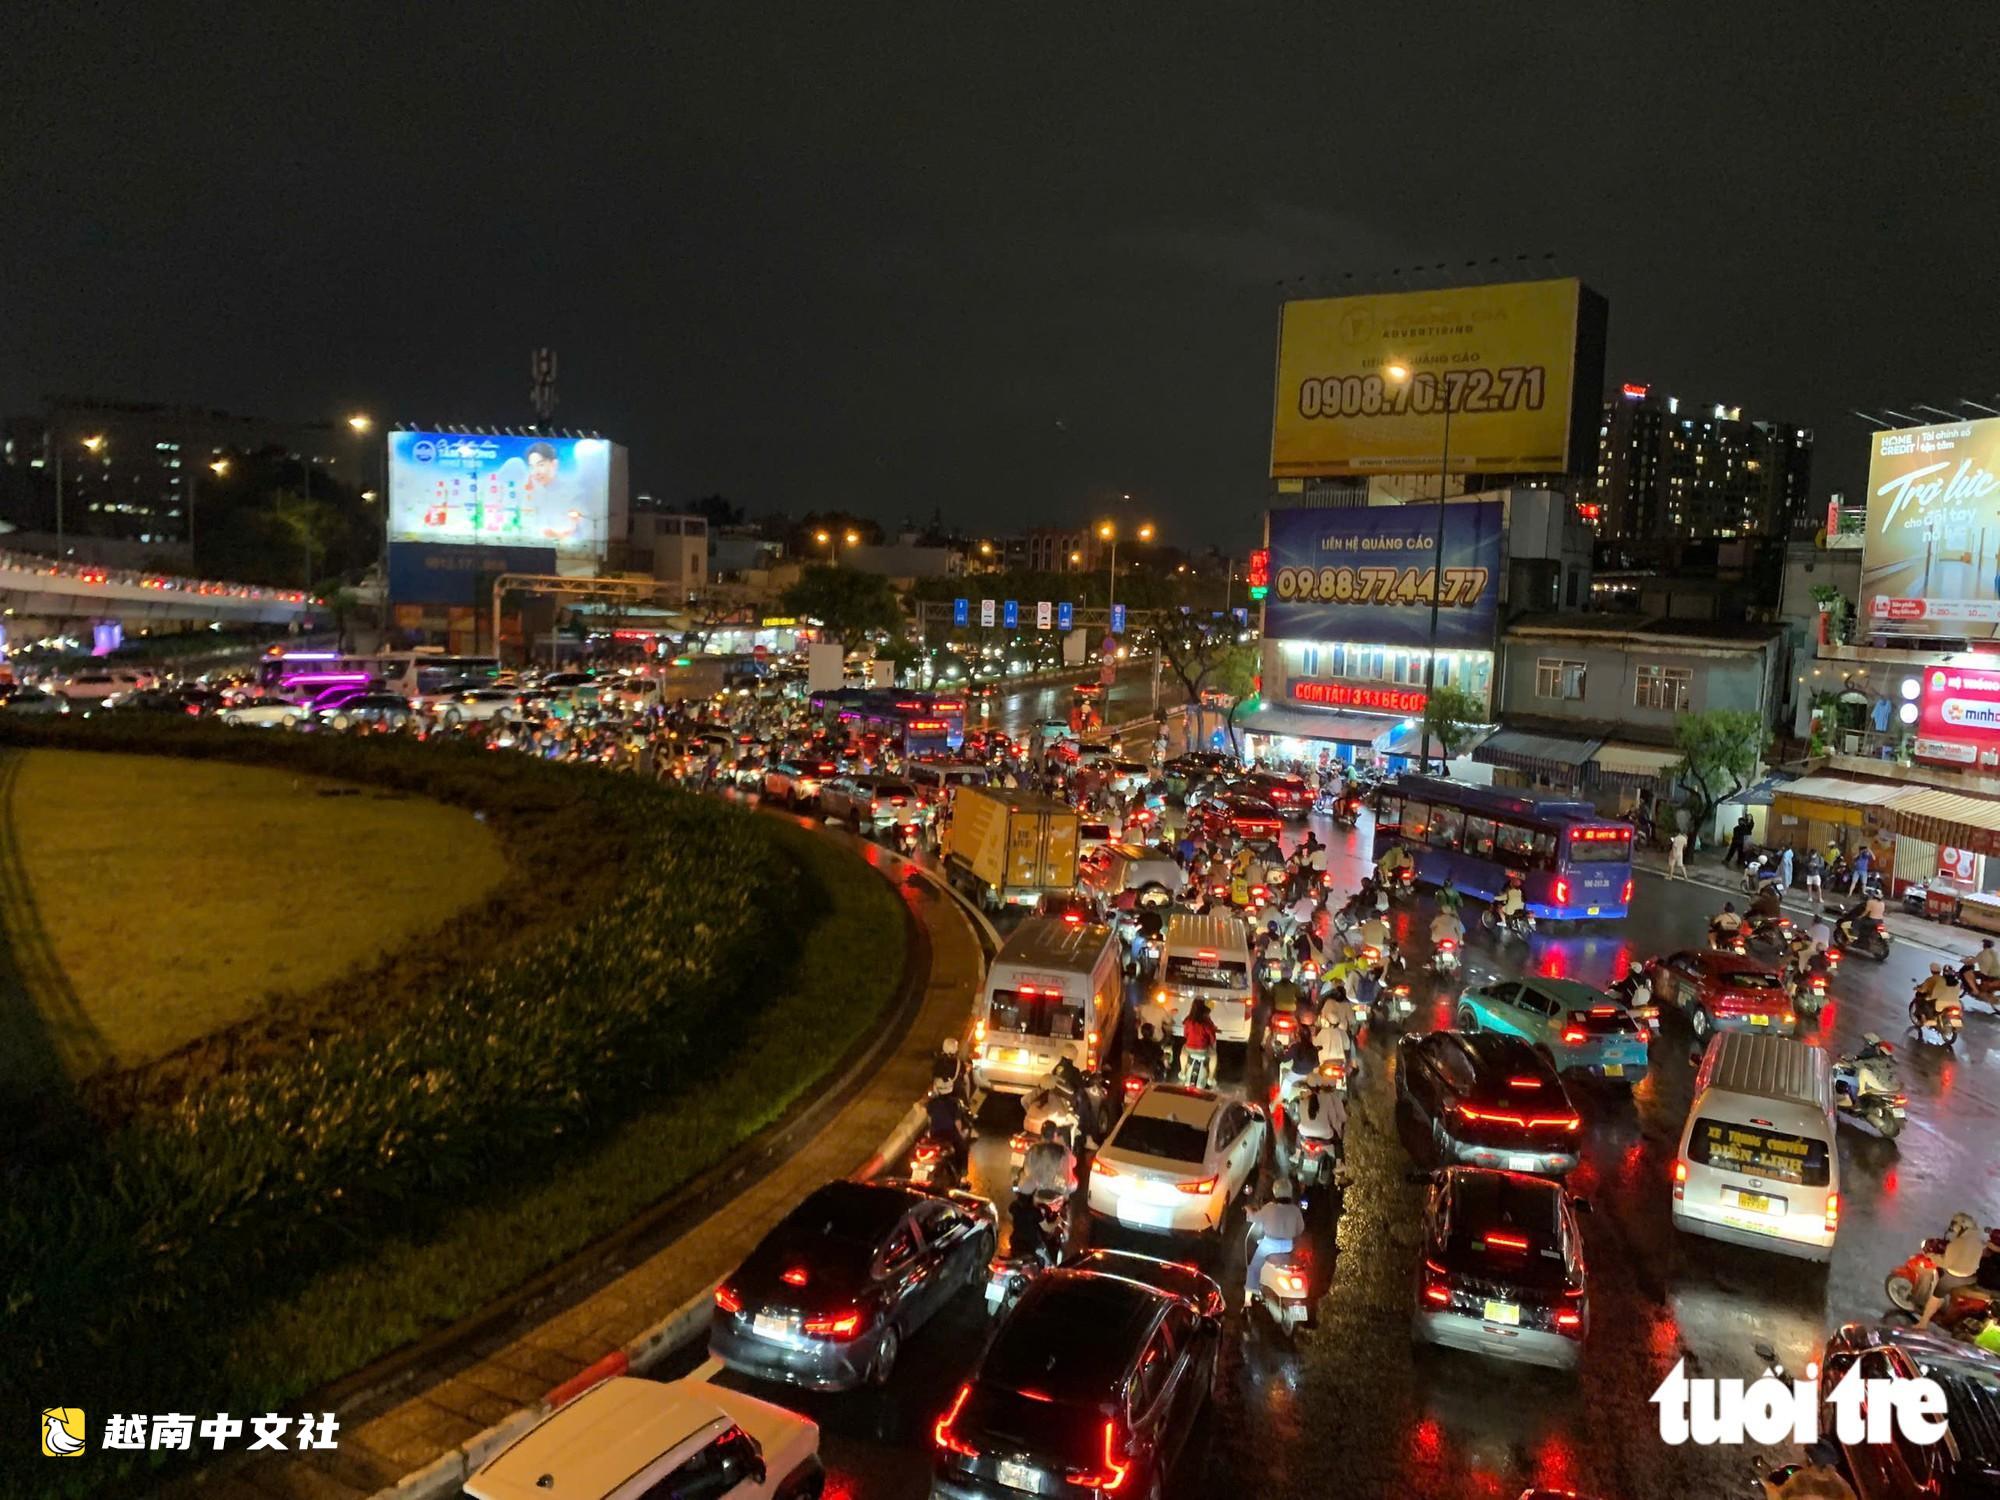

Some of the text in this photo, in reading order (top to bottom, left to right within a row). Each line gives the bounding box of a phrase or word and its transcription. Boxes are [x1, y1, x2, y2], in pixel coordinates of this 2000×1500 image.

[1299, 365, 1545, 420] 0908.70.72.71
[1880, 444, 1915, 456] CREDIT
[1881, 434, 1912, 447] HOME
[1321, 533, 1434, 552] LIÊN HỆ QUẢNG CÁO
[1276, 566, 1488, 609] 09.88.77.44.77
